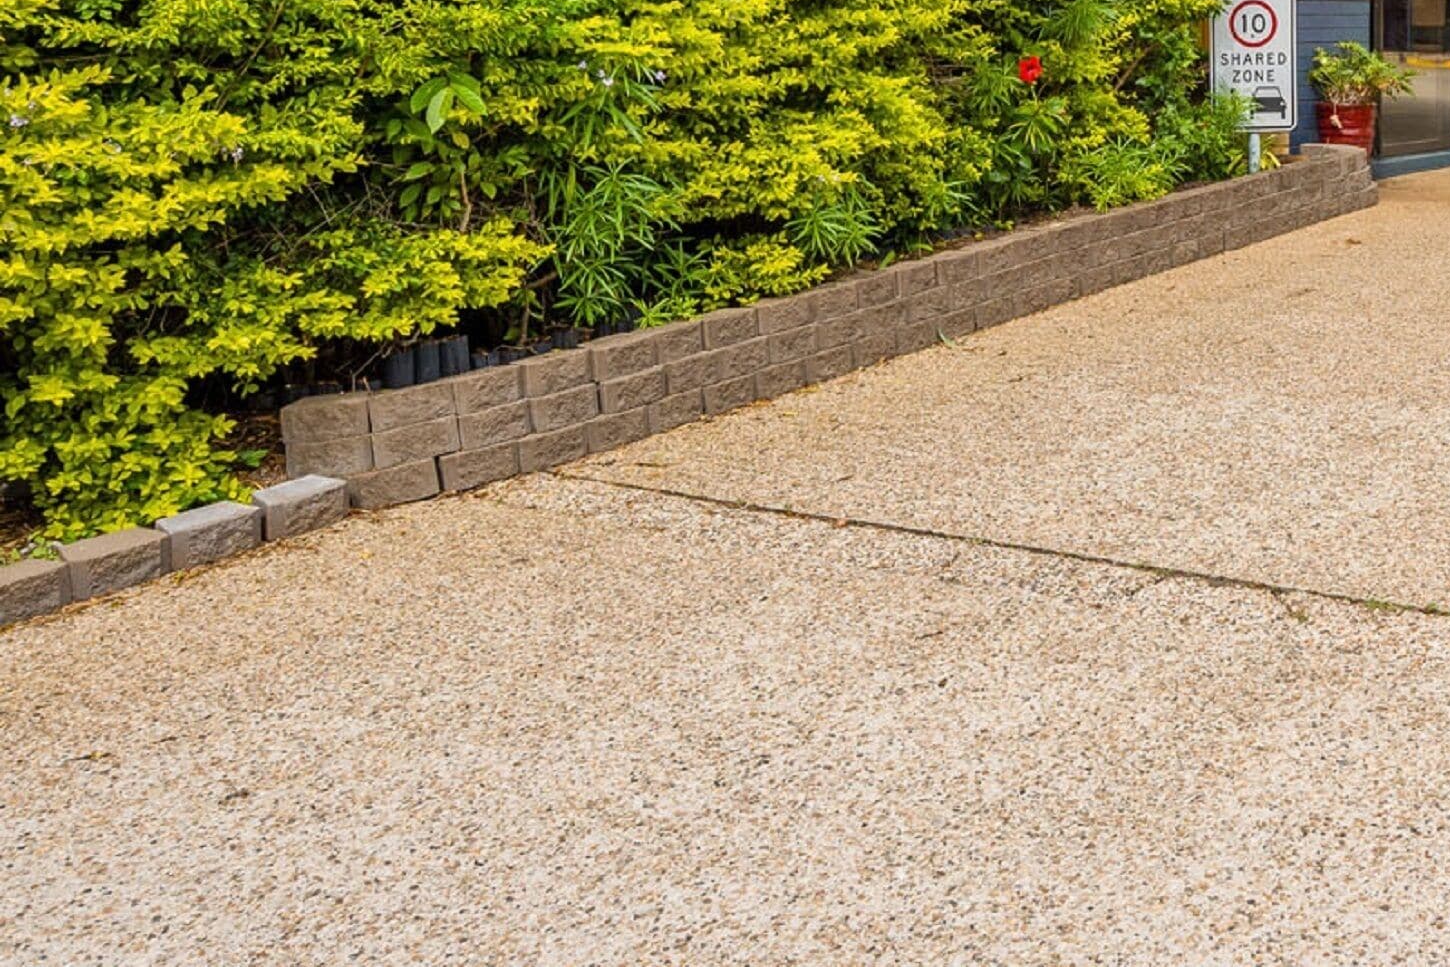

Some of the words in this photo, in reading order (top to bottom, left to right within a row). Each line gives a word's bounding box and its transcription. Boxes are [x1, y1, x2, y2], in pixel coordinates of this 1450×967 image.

[1241, 13, 1266, 33] 10
[1220, 52, 1287, 66] SHARED
[1232, 69, 1275, 84] ZONE
